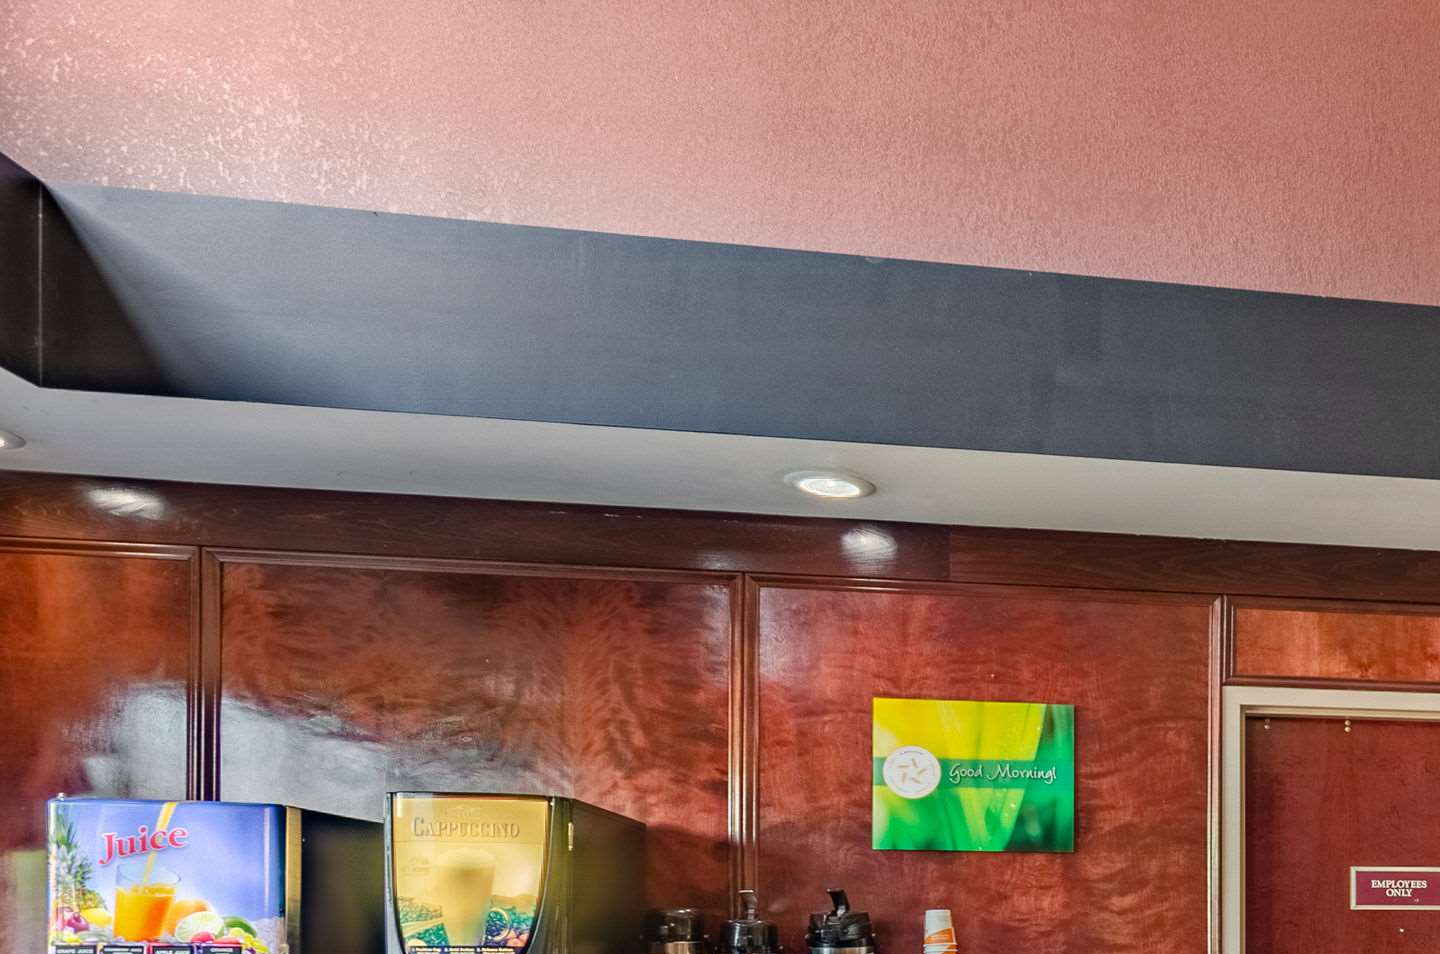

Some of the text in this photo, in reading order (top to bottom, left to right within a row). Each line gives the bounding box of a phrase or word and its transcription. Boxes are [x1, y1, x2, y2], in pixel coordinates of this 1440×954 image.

[949, 763, 1057, 784] Good Morning!
[413, 816, 521, 839] CAPPUCCINO
[98, 825, 189, 864] Juice
[1370, 879, 1428, 889] EMPLOYEES
[1385, 888, 1413, 897] ONLY
